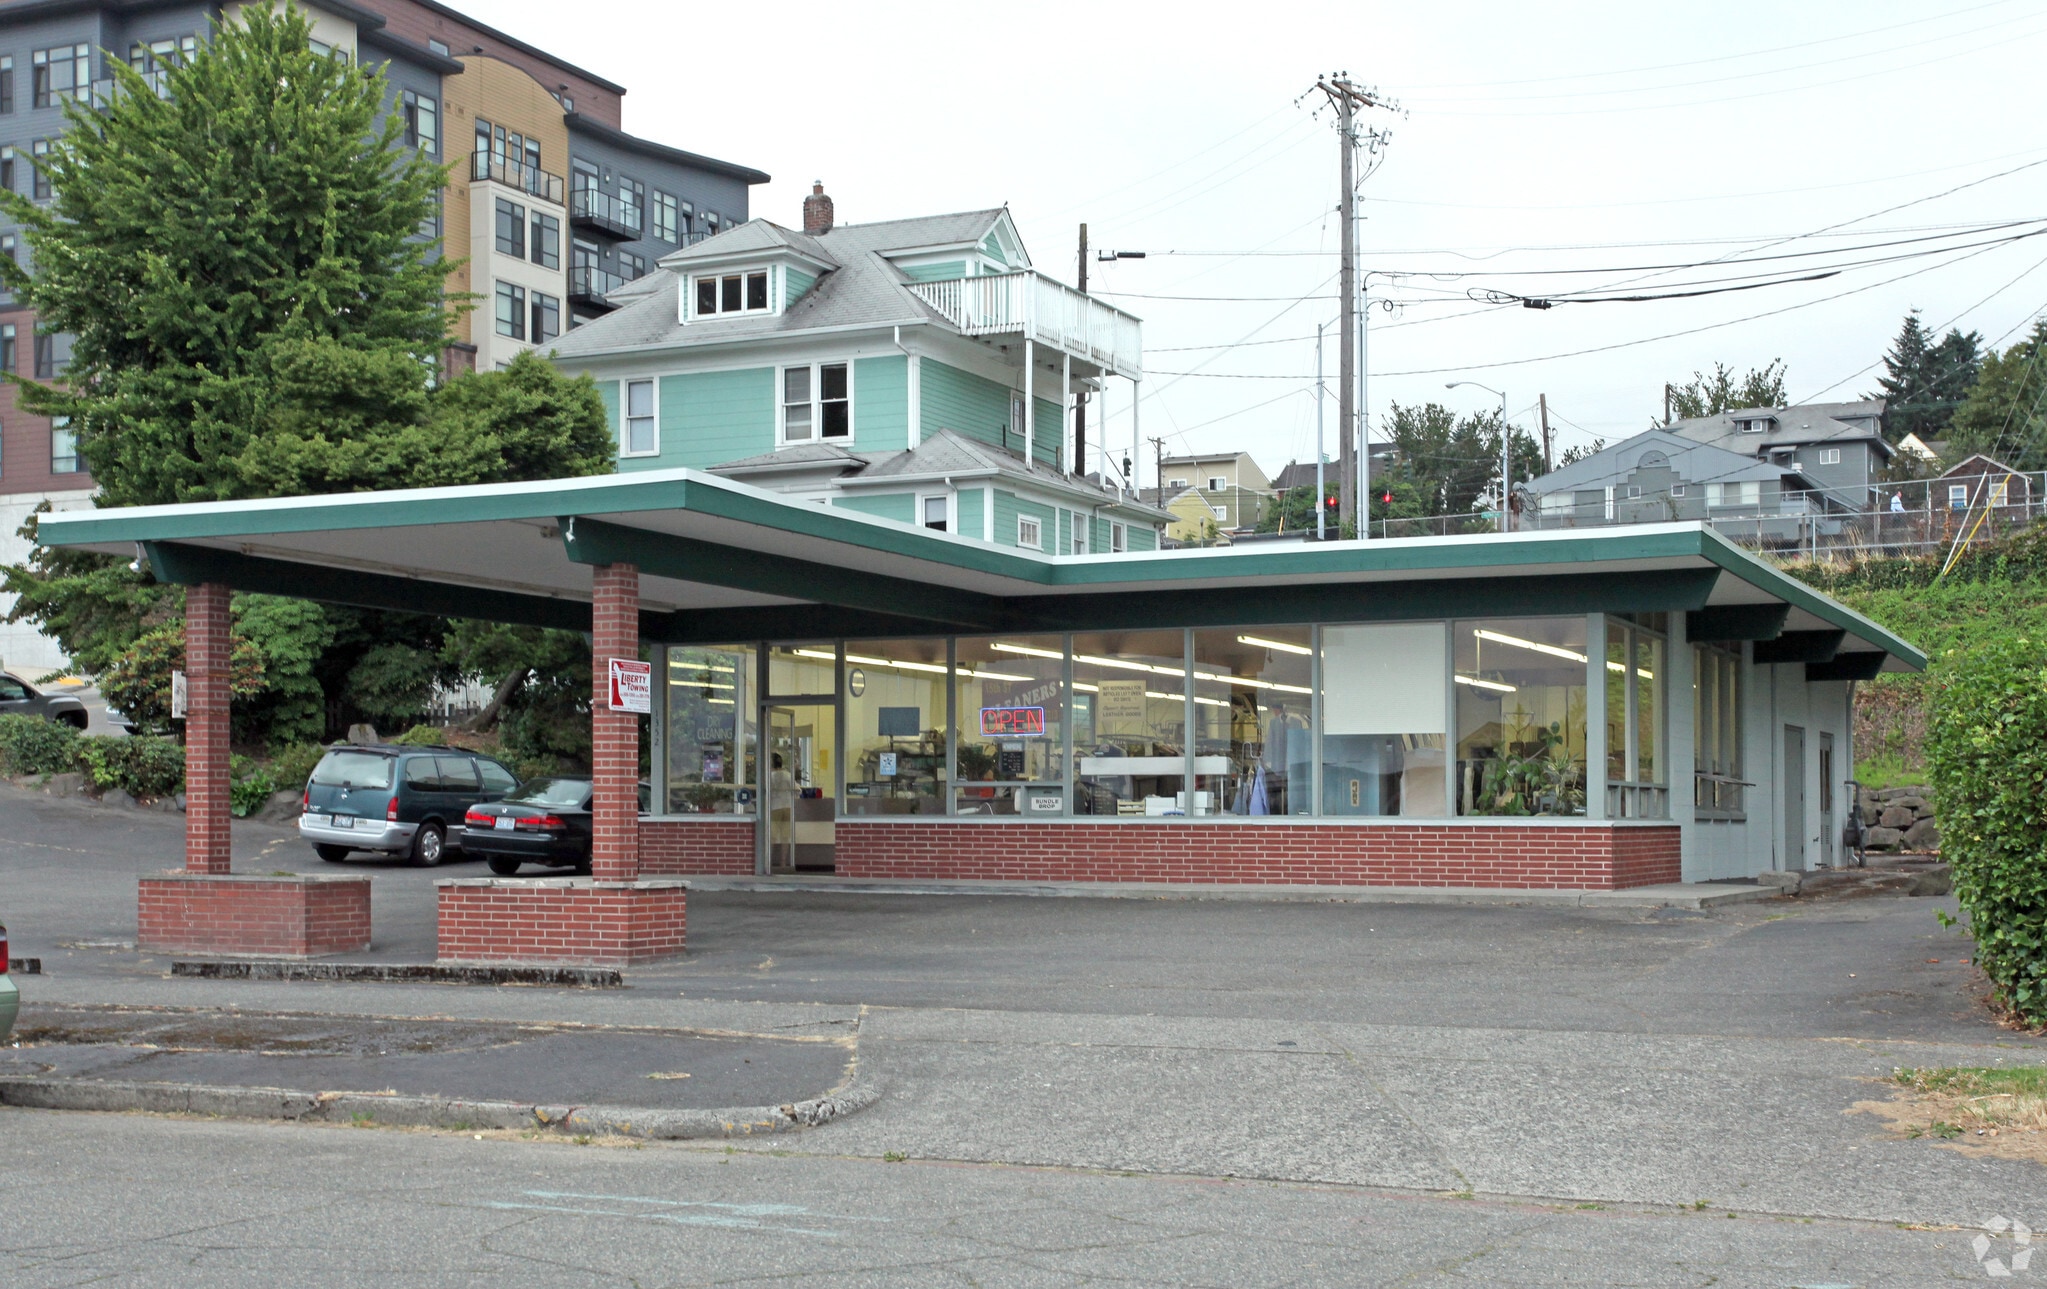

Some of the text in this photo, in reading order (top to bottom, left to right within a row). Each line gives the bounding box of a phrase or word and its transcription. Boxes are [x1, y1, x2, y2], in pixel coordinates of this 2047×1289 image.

[621, 672, 646, 685] LIBERTY
[627, 683, 649, 692] TOWING
[982, 708, 1043, 734] OPEN
[697, 727, 733, 740] CLEANING
